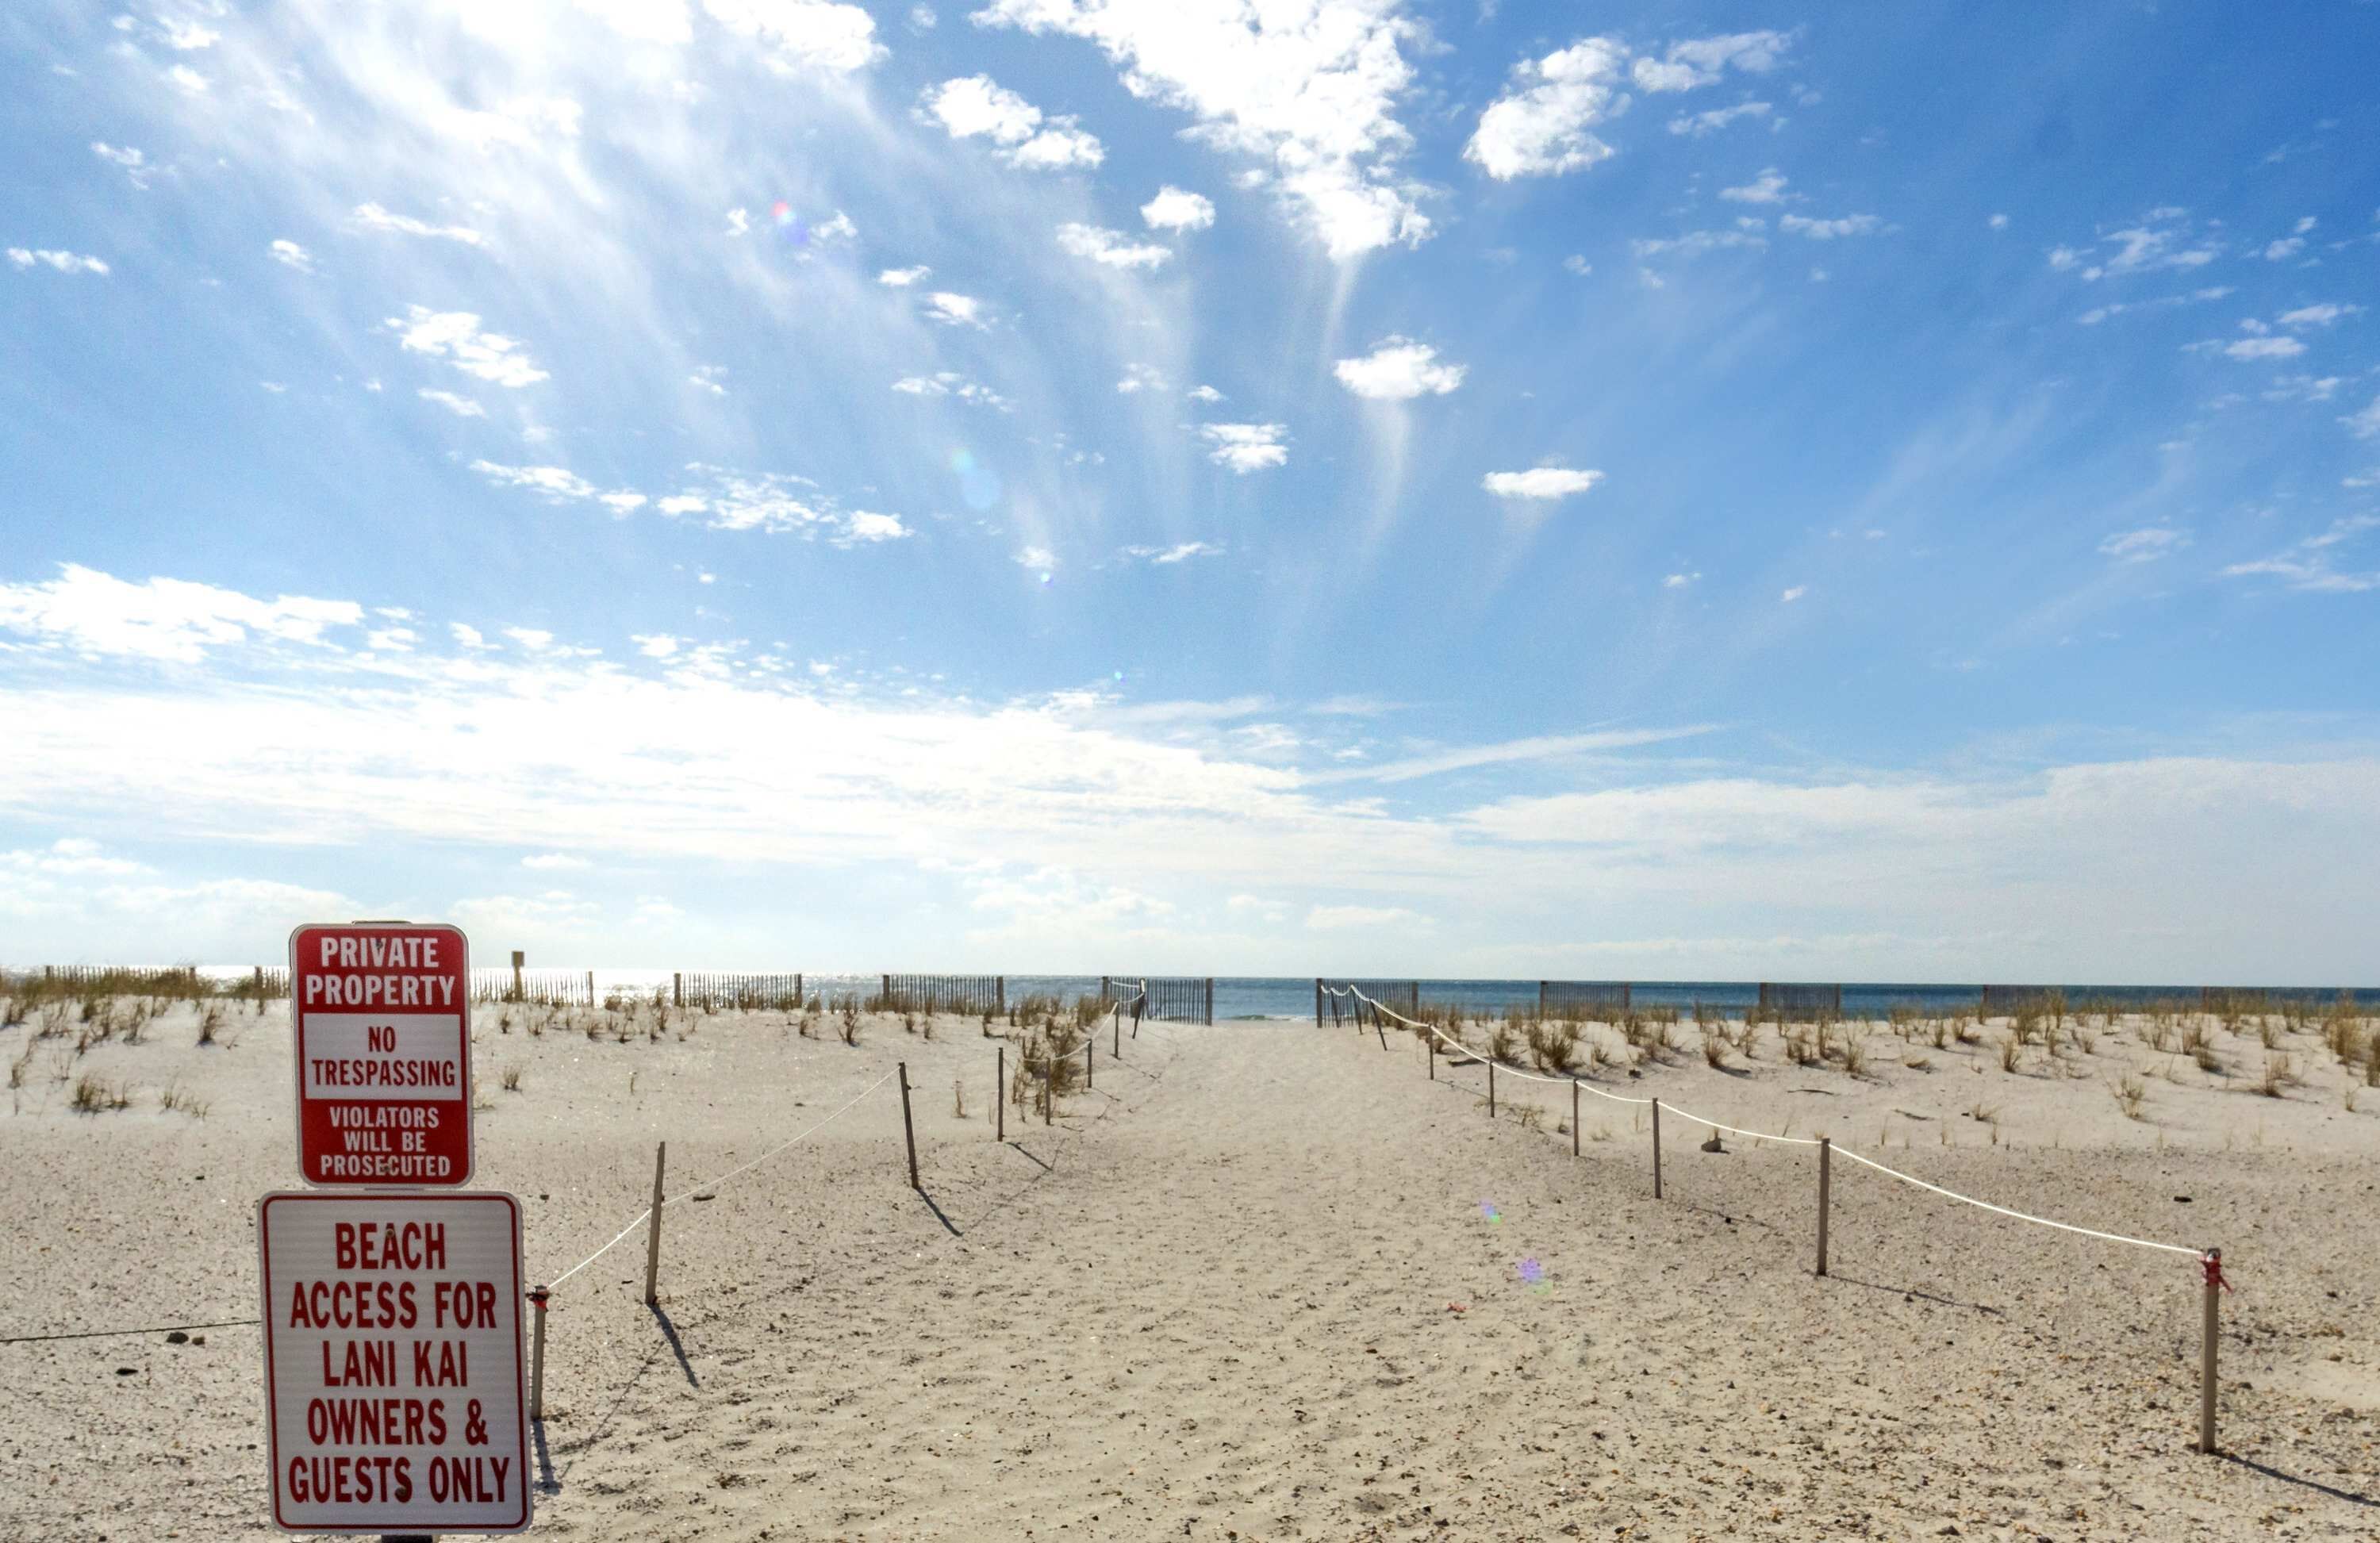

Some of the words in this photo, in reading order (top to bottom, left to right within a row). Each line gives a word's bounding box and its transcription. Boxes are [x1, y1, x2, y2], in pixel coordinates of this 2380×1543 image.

[321, 937, 439, 968] PRIVATE
[305, 974, 455, 1005] PROPERTY
[368, 1026, 396, 1053] NO
[312, 1059, 455, 1087] TRESPASSING
[329, 1106, 440, 1128] VIOLATORS
[344, 1130, 392, 1152] WILL
[402, 1131, 426, 1152] BE
[321, 1155, 451, 1176] PROSECUTED
[335, 1222, 446, 1269] BEACH
[290, 1281, 418, 1329] ACCESS
[434, 1281, 497, 1329] FOR
[322, 1340, 397, 1387] LANI
[413, 1340, 468, 1387] KAI
[307, 1398, 447, 1445] OWNERS
[465, 1398, 489, 1445] &
[288, 1456, 413, 1503] GUESTS
[428, 1456, 510, 1503] ONLY
